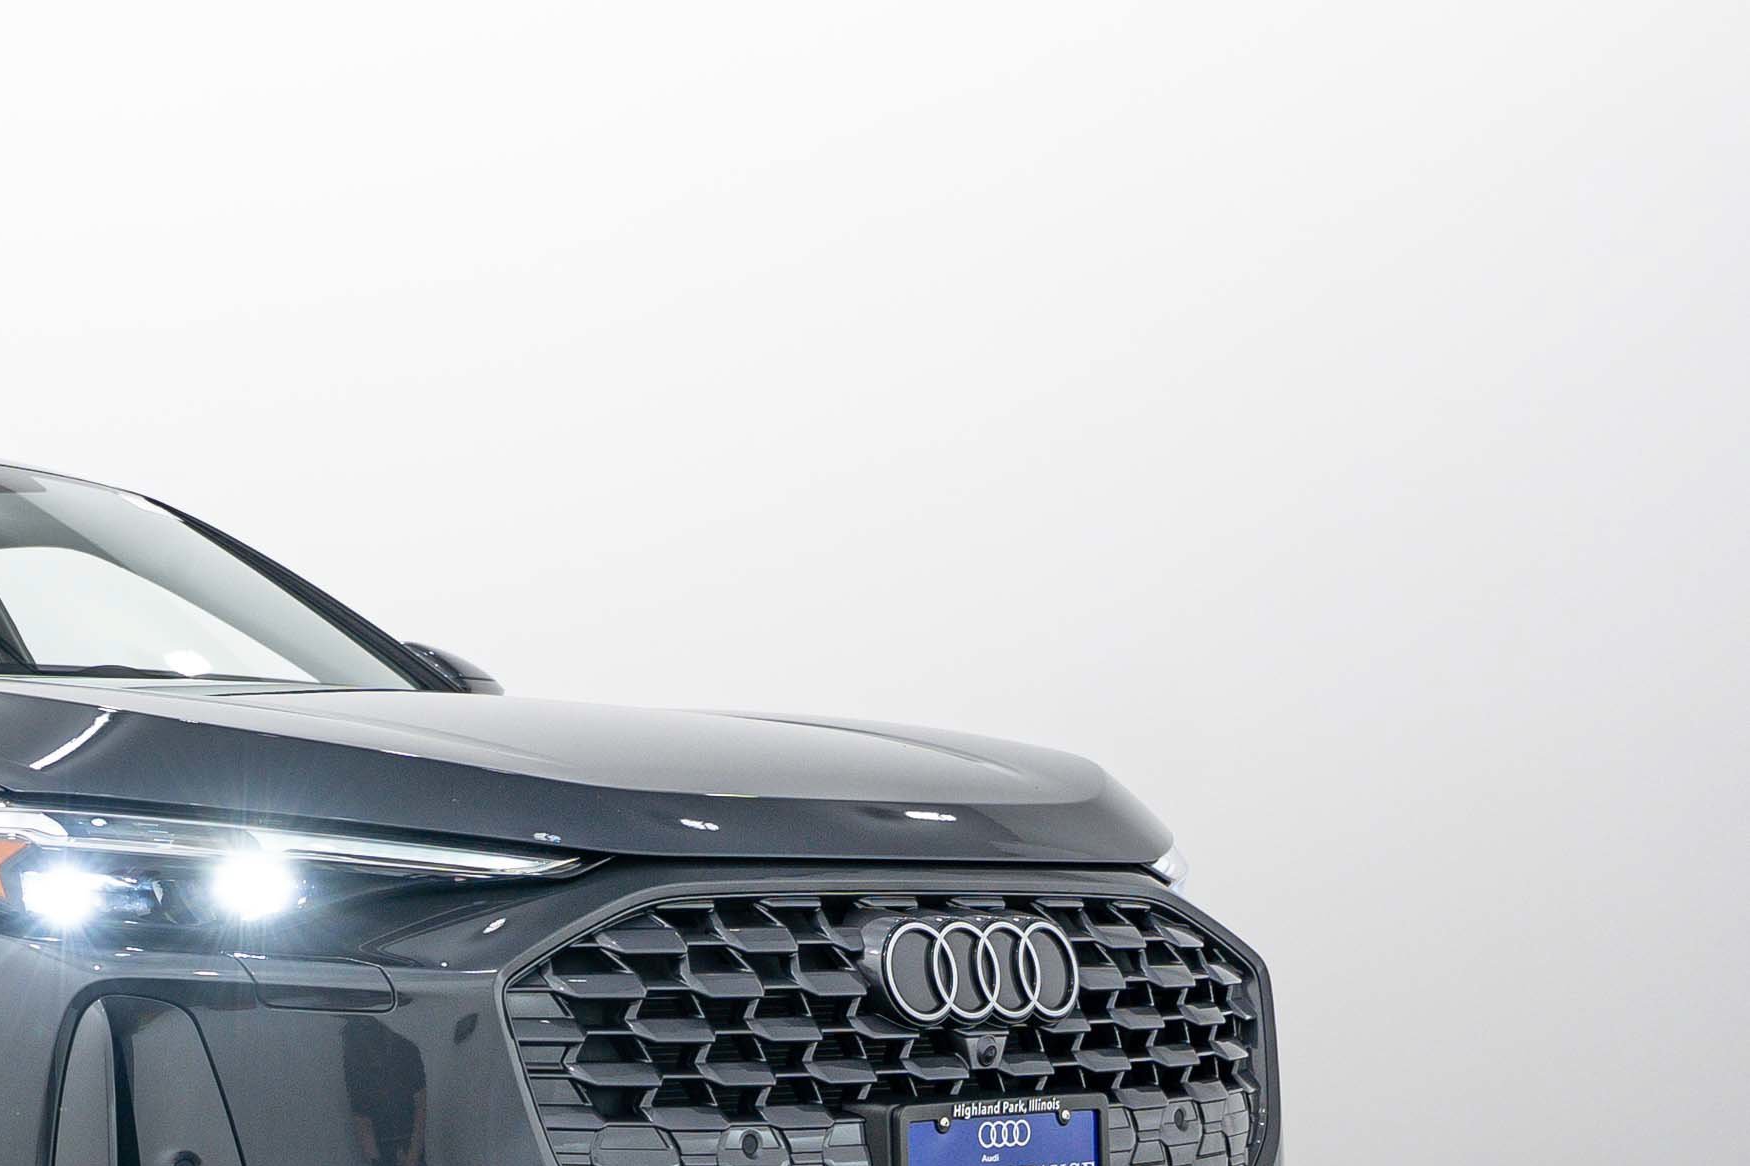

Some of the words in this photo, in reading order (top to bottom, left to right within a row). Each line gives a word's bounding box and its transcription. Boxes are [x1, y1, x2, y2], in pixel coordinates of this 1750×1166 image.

[953, 1102, 1001, 1119] Highland
[1002, 1100, 1027, 1115] Park,
[1029, 1097, 1060, 1112] Illinois
[981, 1154, 999, 1162] Audi
